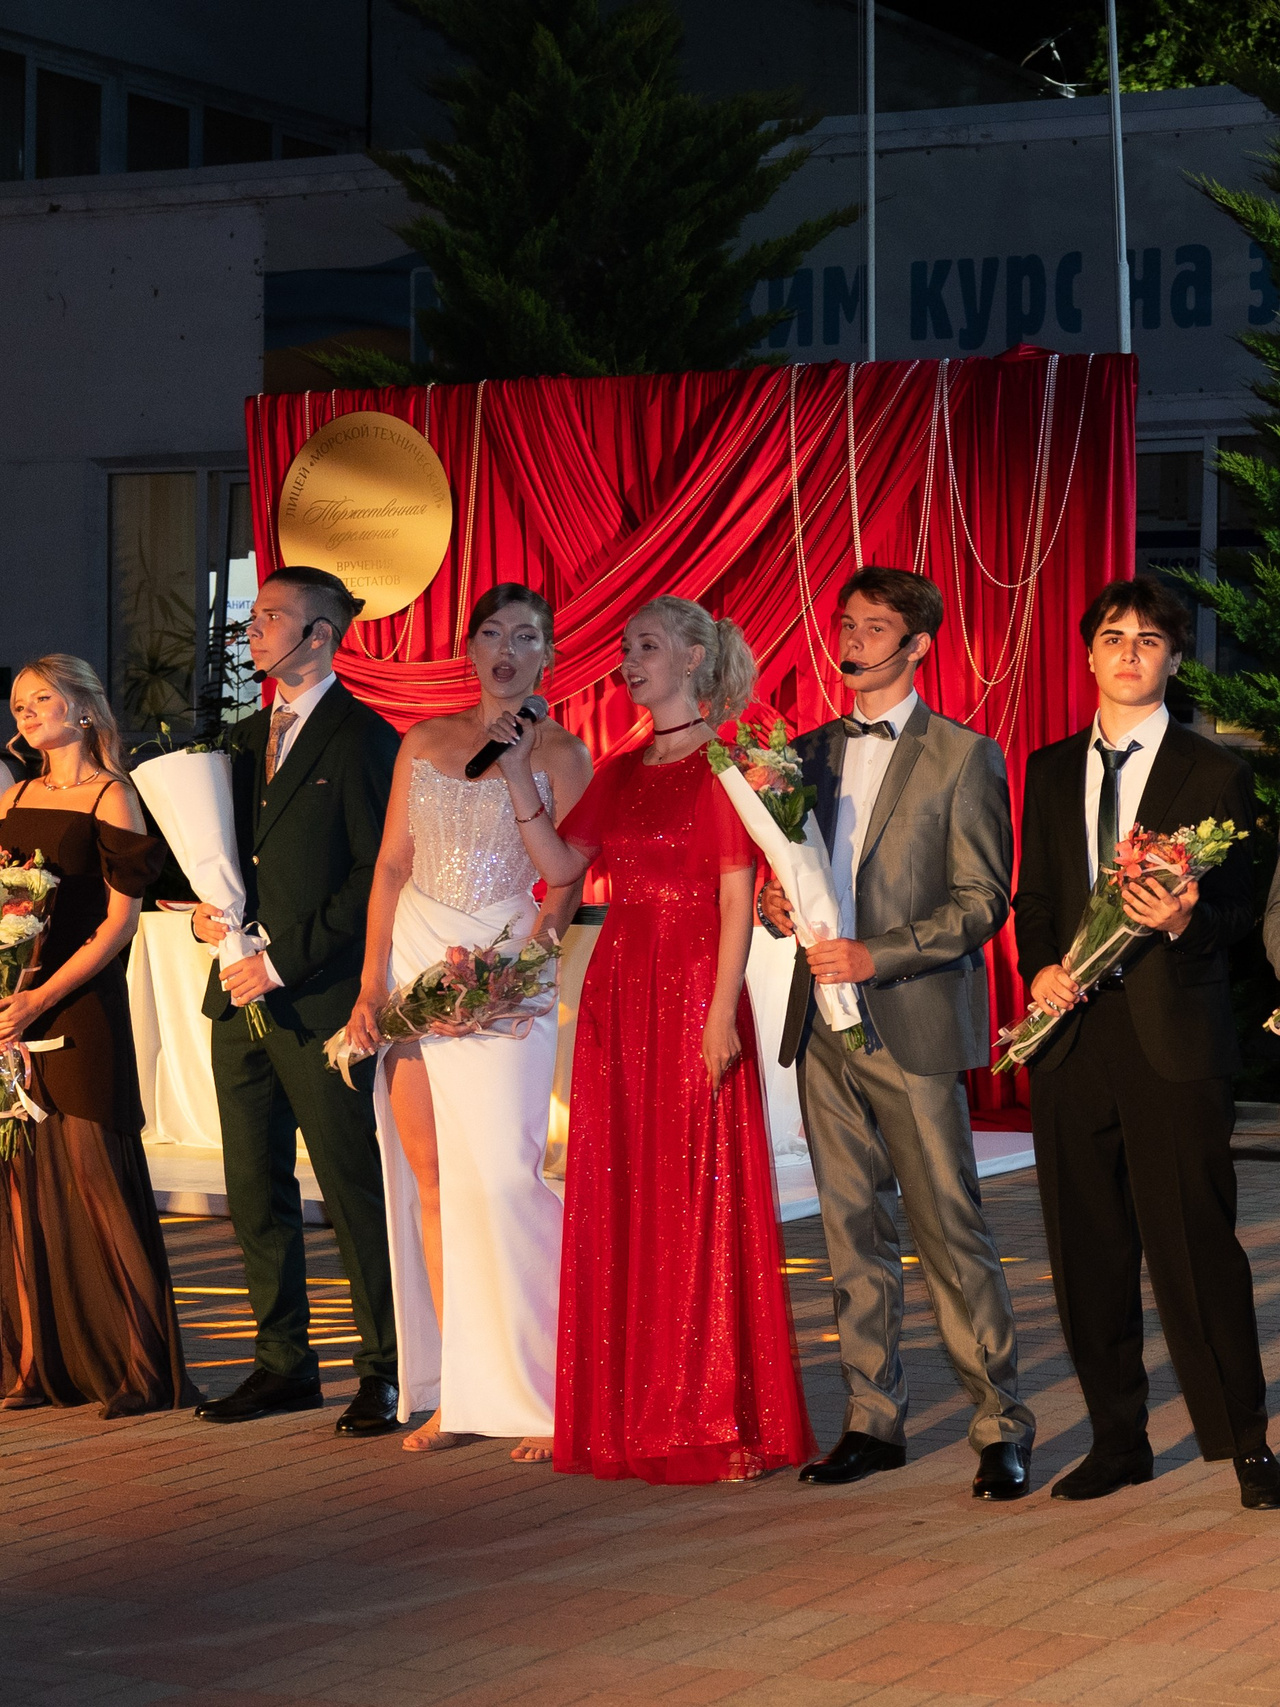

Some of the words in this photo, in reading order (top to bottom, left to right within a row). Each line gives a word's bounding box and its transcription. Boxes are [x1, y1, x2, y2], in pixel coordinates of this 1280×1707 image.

[910, 250, 1082, 350] курс
[1128, 244, 1213, 330] на
[286, 466, 310, 518] ЛИЦЕЙ
[303, 496, 427, 529] Торжественная
[326, 528, 400, 552] церемония
[336, 559, 394, 572] ВРУЧЕНИЯ
[342, 575, 401, 588] ТЕСТАТОВ
